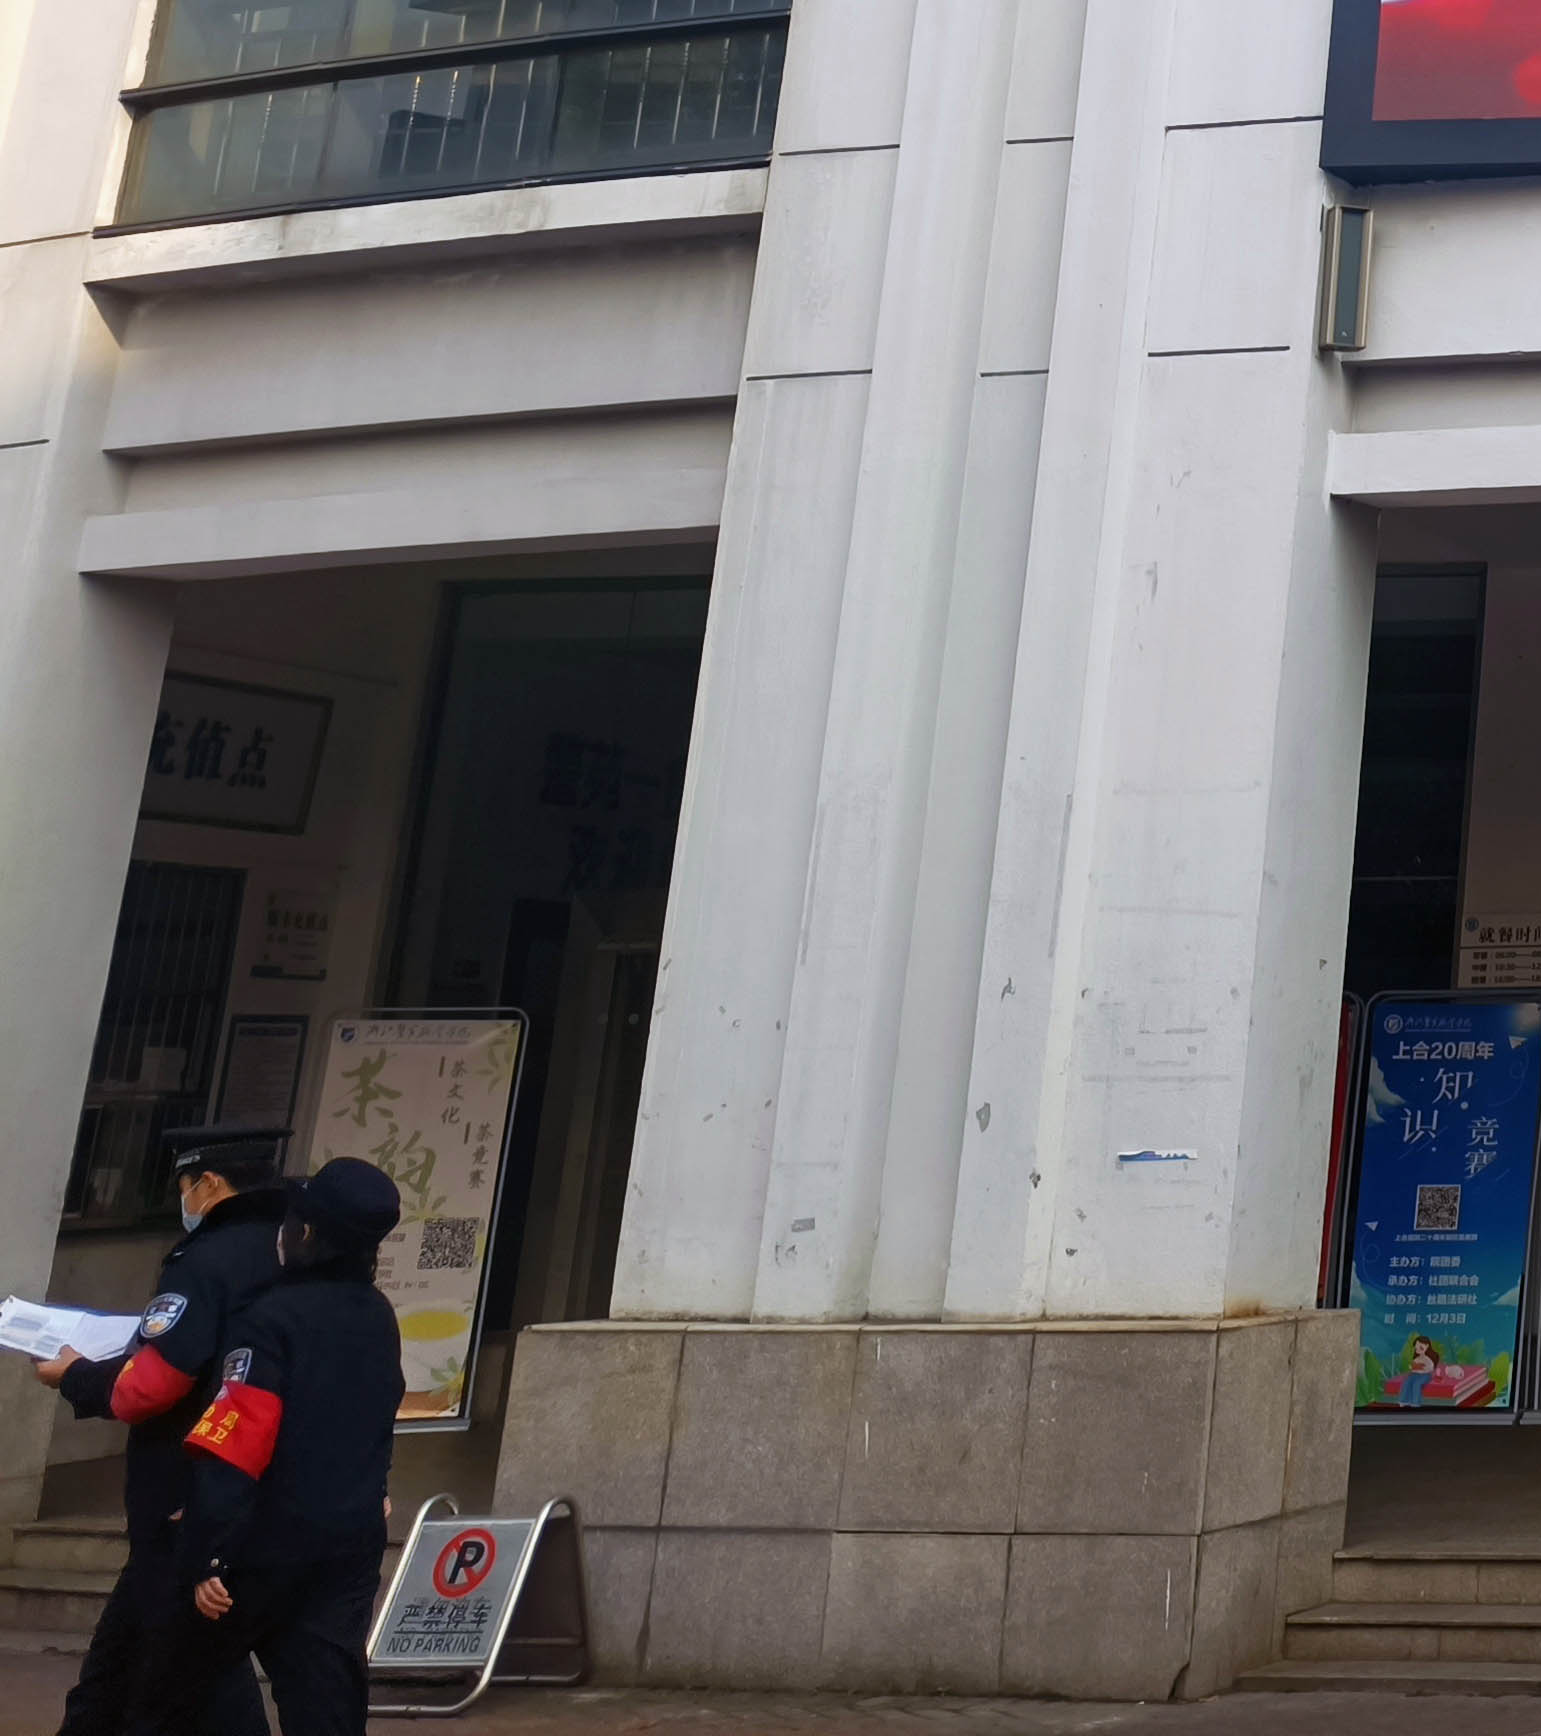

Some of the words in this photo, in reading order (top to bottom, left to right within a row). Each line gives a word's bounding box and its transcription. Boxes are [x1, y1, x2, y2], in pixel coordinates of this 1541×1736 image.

[1392, 1040, 1495, 1061] 上合20周年
[441, 1059, 468, 1125] 茶文化
[1464, 1115, 1501, 1179] 竞赛
[397, 1603, 493, 1630] 严禁停车
[386, 1637, 412, 1654] NO
[412, 1635, 483, 1654] PARKING
